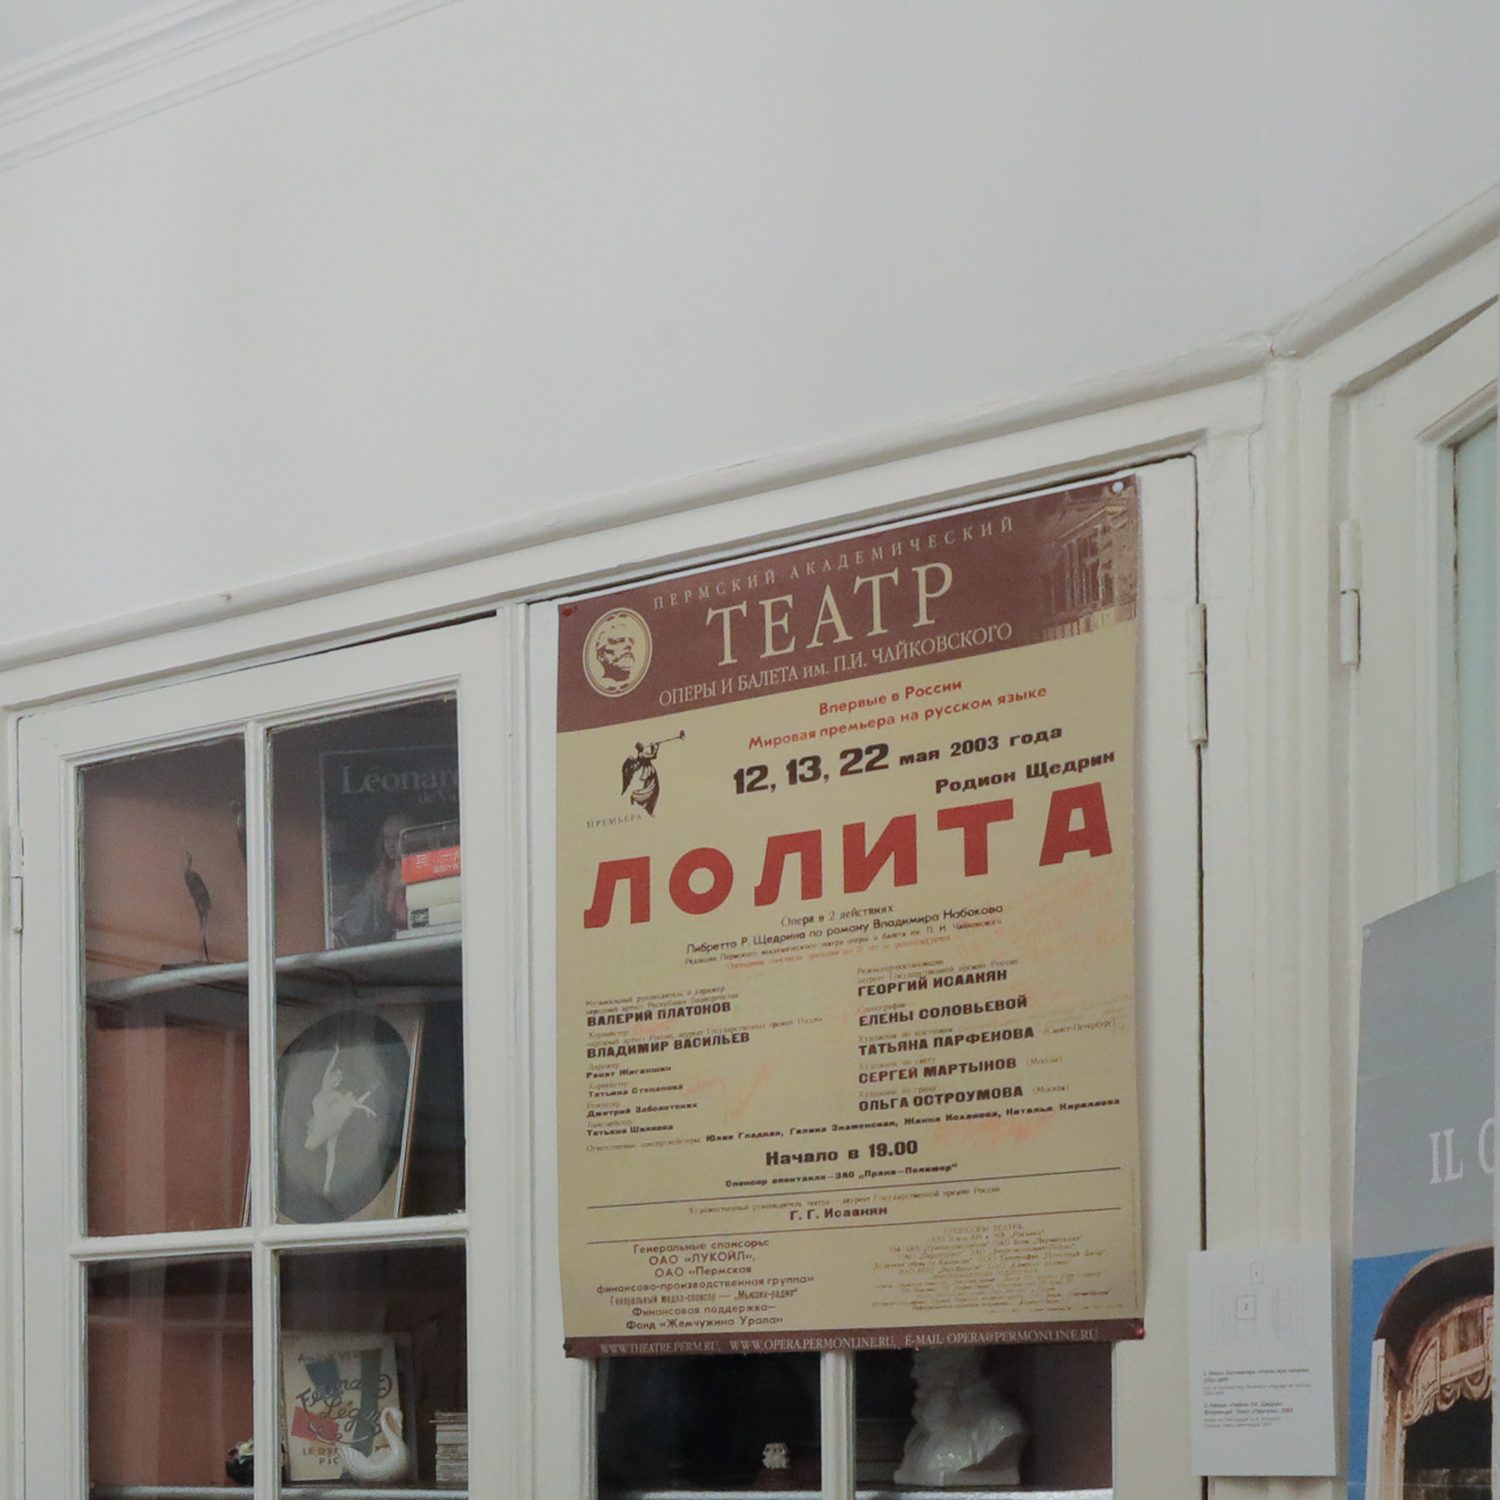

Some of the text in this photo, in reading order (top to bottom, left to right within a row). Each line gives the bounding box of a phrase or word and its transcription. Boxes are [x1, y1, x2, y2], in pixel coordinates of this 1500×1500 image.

[653, 516, 1013, 610] ПЕРМСКИЙ АКАДЕМИЧЕСКИЙ
[706, 562, 953, 667] ТЕАТР
[659, 622, 1012, 707] ОПЕРЫ И БАЛЕТА им. П.И. ЧАЙКОВСКОГО
[819, 681, 962, 716] Впервые в России
[748, 686, 1047, 751] Мировая премьера на русском языке
[733, 726, 1062, 794] 12, 13, 22 мая 2003 года
[936, 751, 1115, 794] Родион Щедрин
[583, 781, 1114, 929] ЛОЛИТА
[686, 904, 1004, 954] Либретто Щедрина по роману Владимира Набокова
[781, 914, 815, 928] Опера
[828, 910, 835, 922] 2
[839, 904, 894, 920] действиях
[857, 976, 928, 997] ГЕОРГИЙ
[587, 1001, 732, 1027] ВАЛЕРИЙ ПЛАТОНОВ
[858, 994, 1028, 1027] ЕЛЕНЫ СОЛОВЬЕВОЙ
[587, 1032, 750, 1059] ВЛАДИМИР ВАСИЛЬЕВ
[858, 1038, 929, 1056] ТАТЬЯНА
[933, 1026, 1035, 1048] ПАРФЕНОВА
[858, 1066, 919, 1084] СЕРГЕЙ
[923, 1057, 1017, 1078] МАРТЫНОВ
[858, 1096, 909, 1112] ОЛЬГА
[913, 1086, 1024, 1107] ОСТРОУМОВА
[765, 1140, 919, 1167] Начало в 19.00
[789, 1209, 803, 1221] Г.
[806, 1208, 820, 1220] Г.
[633, 1237, 770, 1255] Генеральные спонсоры:
[649, 1251, 756, 1266] ОАО «ЛУКОЙЛ»,
[596, 1274, 815, 1295] финансово-производственная группа»
[654, 1265, 752, 1278] ОАО «Пермская
[625, 1315, 784, 1331] Фонд «Жемчужина Урала»
[632, 1306, 700, 1317] Финансовая
